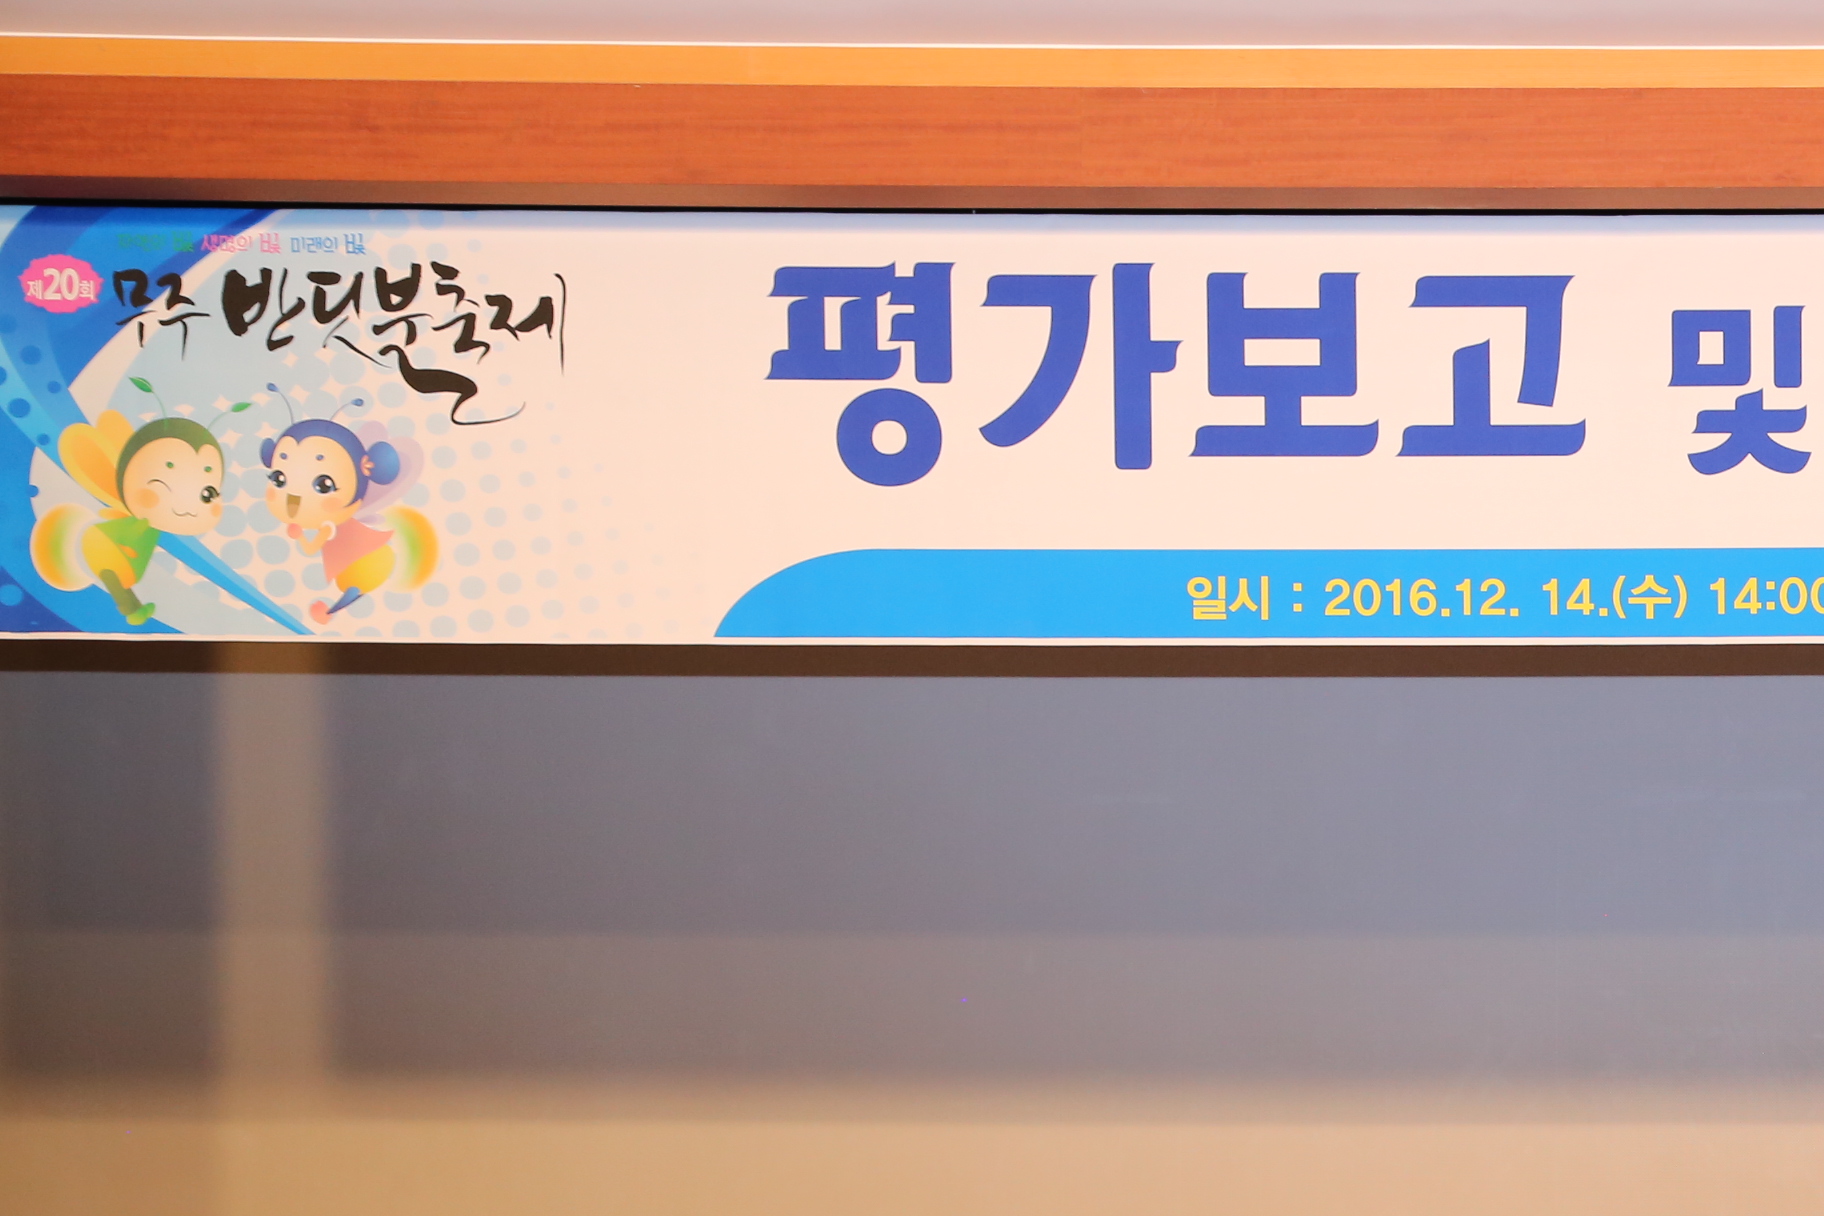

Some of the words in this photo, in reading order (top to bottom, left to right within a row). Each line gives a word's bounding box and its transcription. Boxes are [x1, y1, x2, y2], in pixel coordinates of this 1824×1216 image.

[201, 233, 254, 254] 생명의
[258, 231, 282, 254] 빛
[290, 235, 339, 254] 미래의
[344, 231, 367, 256] 빛
[26, 267, 96, 301] 제20회
[112, 269, 210, 360] 무주
[221, 260, 567, 426] 반딧불축제
[767, 263, 1585, 486] 평가보고
[1670, 306, 1810, 474] 및
[1188, 576, 1268, 619] 일시
[1294, 583, 1302, 611] :
[1326, 579, 1518, 616] 2016.12.
[1544, 575, 1686, 619] 14.(수)
